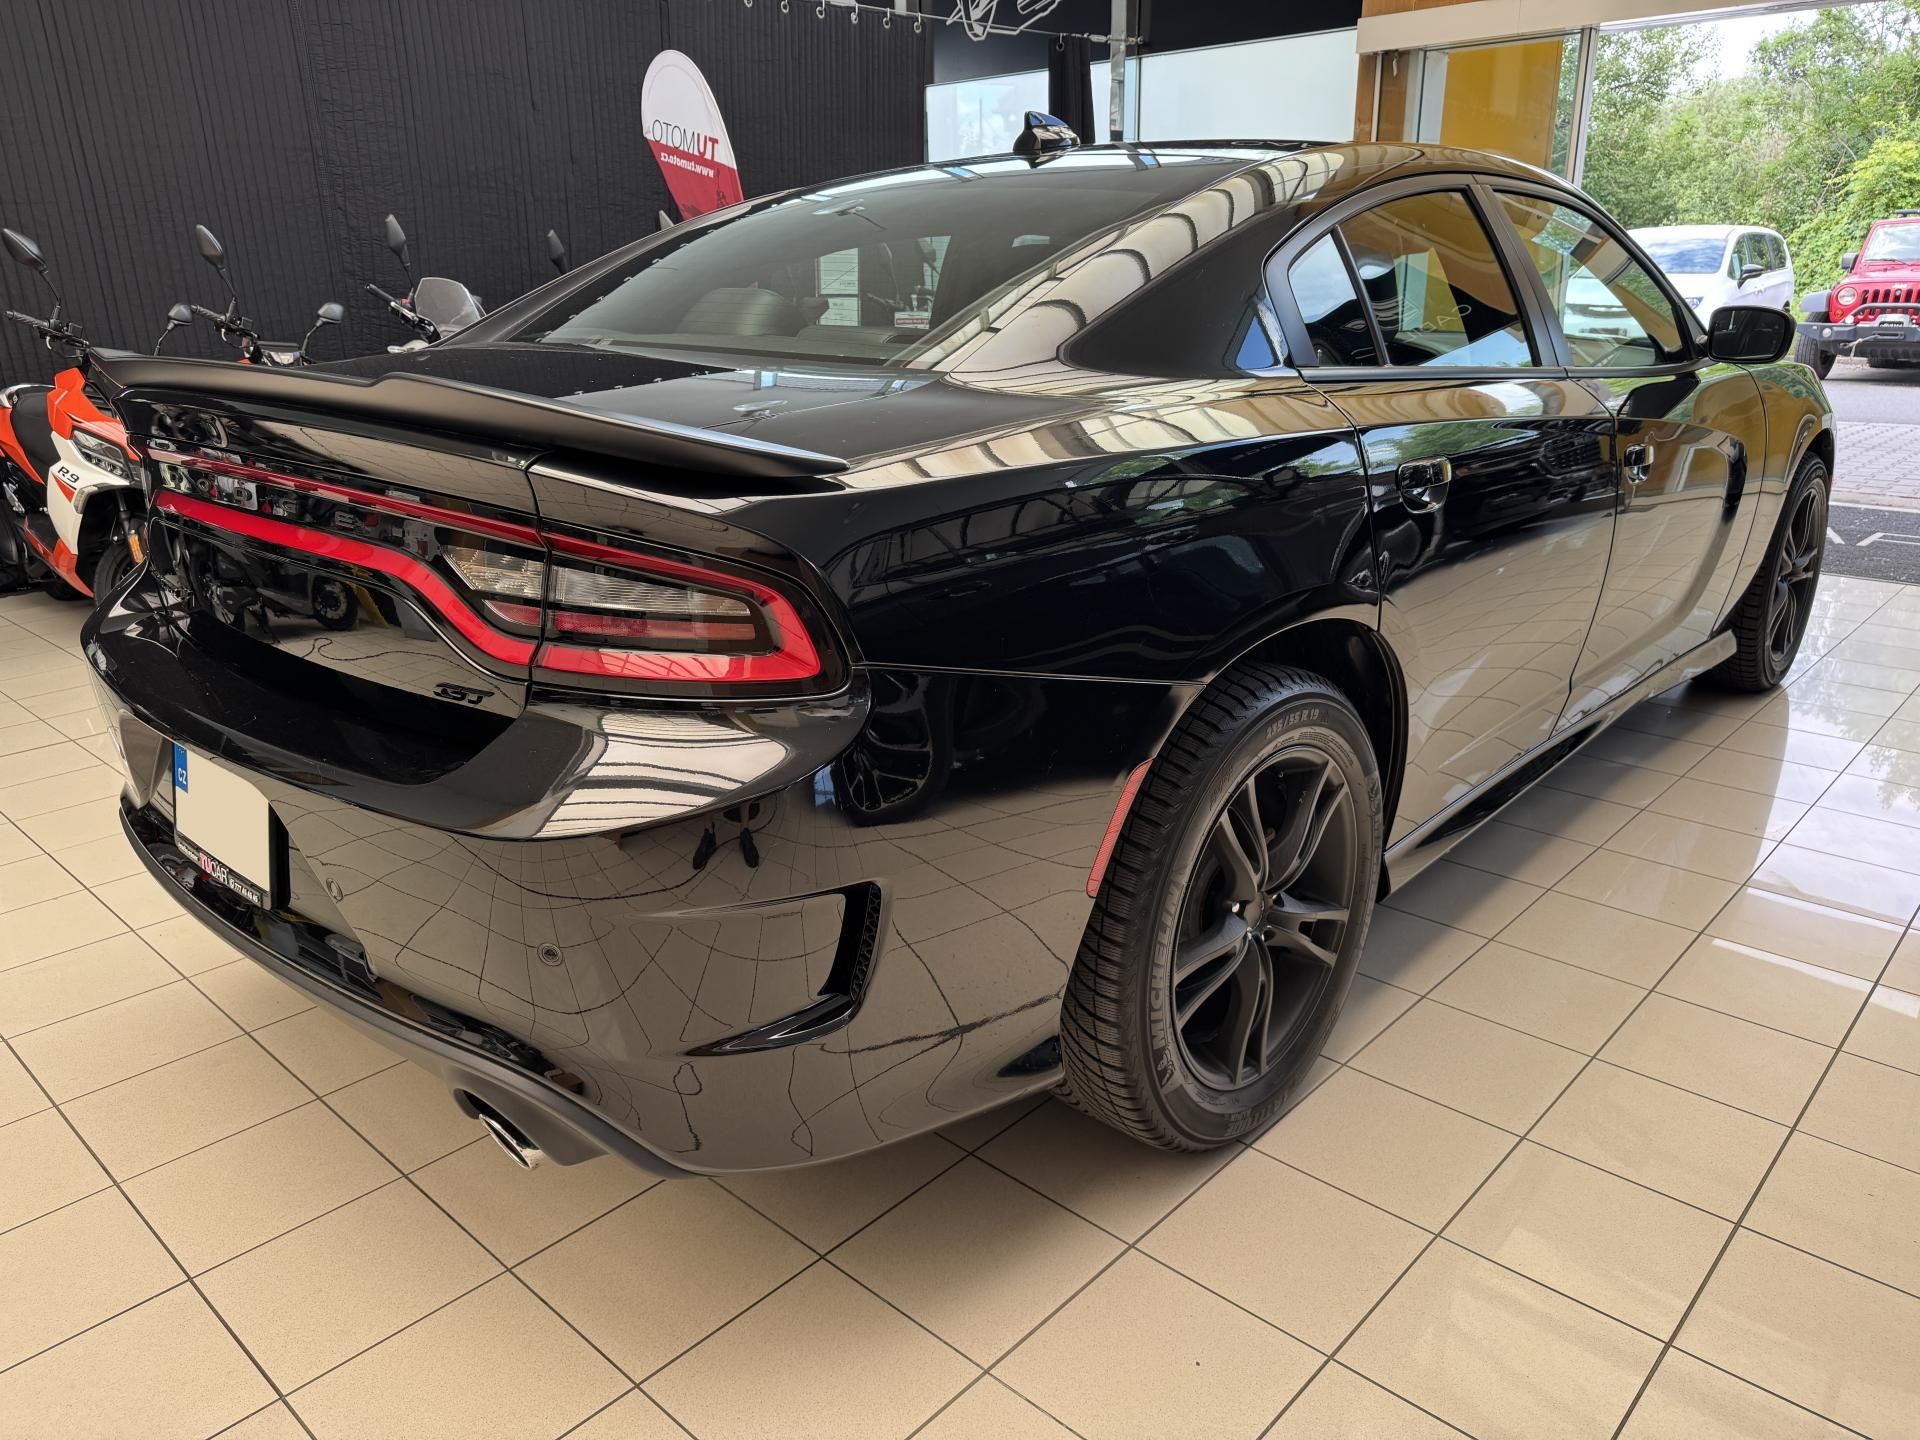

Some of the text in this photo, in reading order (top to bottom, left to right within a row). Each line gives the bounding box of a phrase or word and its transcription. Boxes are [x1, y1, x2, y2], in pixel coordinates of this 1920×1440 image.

[57, 466, 80, 484] R9
[433, 682, 495, 704] GT
[177, 767, 187, 785] CZ
[1151, 878, 1183, 1050] MICHELIN
